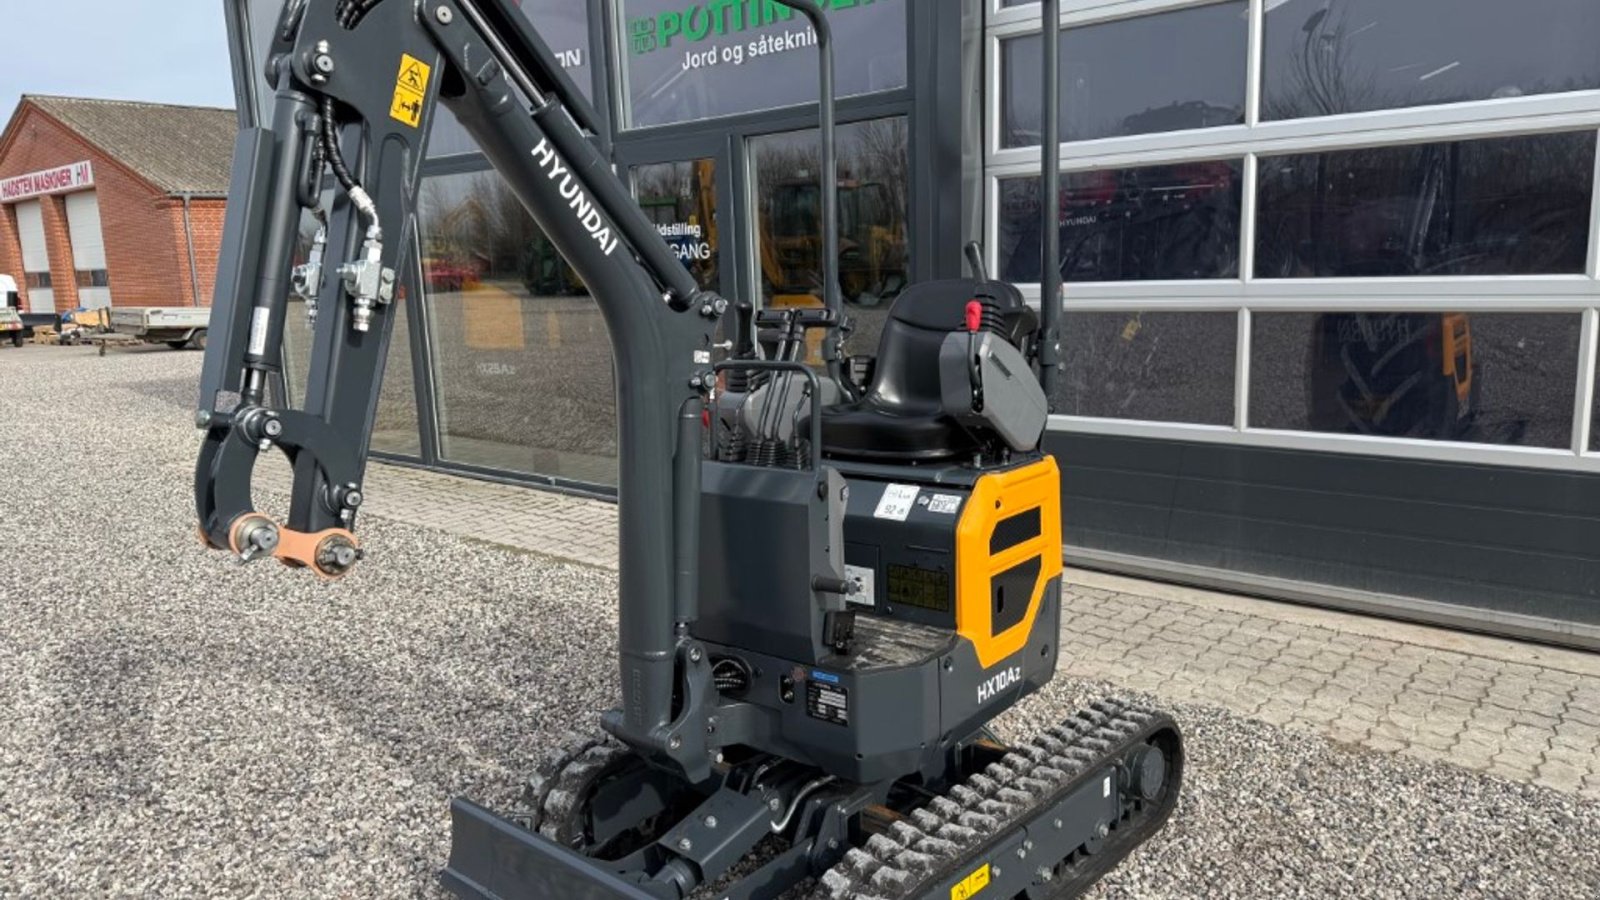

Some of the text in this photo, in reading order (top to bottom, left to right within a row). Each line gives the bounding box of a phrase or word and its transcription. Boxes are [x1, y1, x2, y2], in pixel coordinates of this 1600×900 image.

[682, 45, 717, 70] Jord
[722, 45, 743, 65] og
[530, 136, 619, 256] HYUNDAI
[1059, 215, 1097, 227] HYUNDAI
